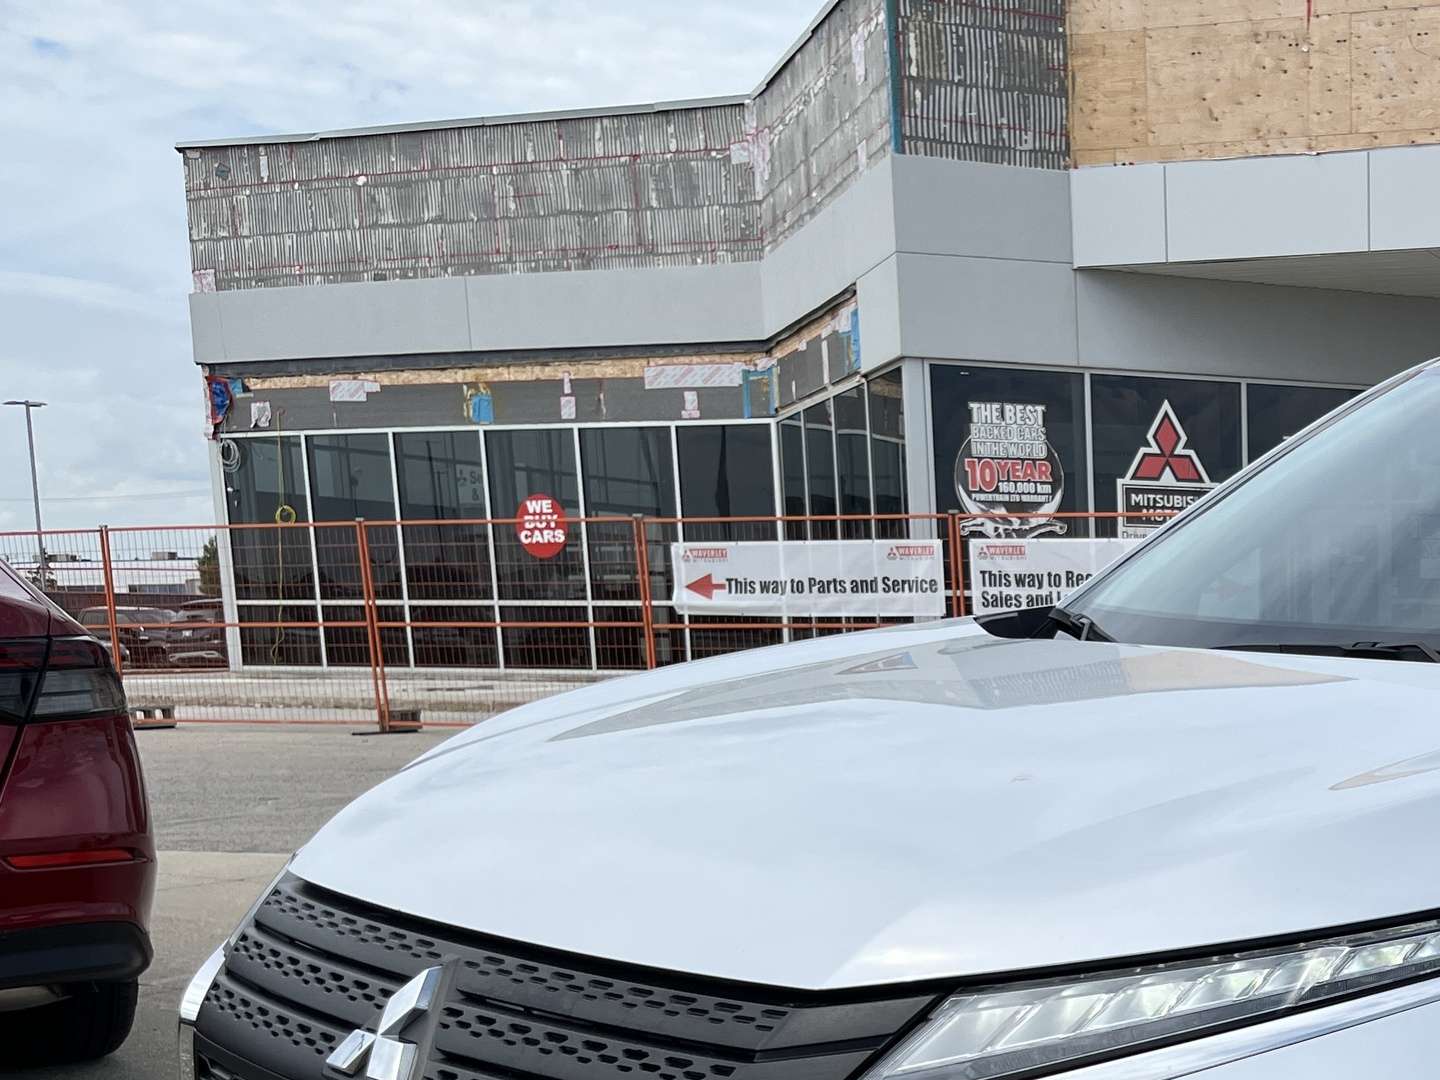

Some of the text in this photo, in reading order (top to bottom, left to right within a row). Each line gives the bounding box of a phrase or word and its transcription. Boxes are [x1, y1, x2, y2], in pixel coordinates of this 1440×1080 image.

[968, 402, 1046, 425] THE BEST
[971, 424, 1047, 441] BACKED CARS
[984, 442, 1007, 457] THE
[1008, 442, 1048, 458] WORLD
[965, 458, 1053, 492] 10 YEAR
[526, 500, 553, 514] WE
[1131, 494, 1198, 508] MITSUBIS
[524, 515, 558, 529] BUY
[520, 530, 565, 544] CARS
[726, 576, 938, 596] This way to Parts and Service
[980, 570, 1012, 588] This
[1014, 574, 1044, 590] way
[1047, 571, 1062, 588] to
[981, 591, 1022, 608] Sales
[1026, 591, 1054, 608] and
